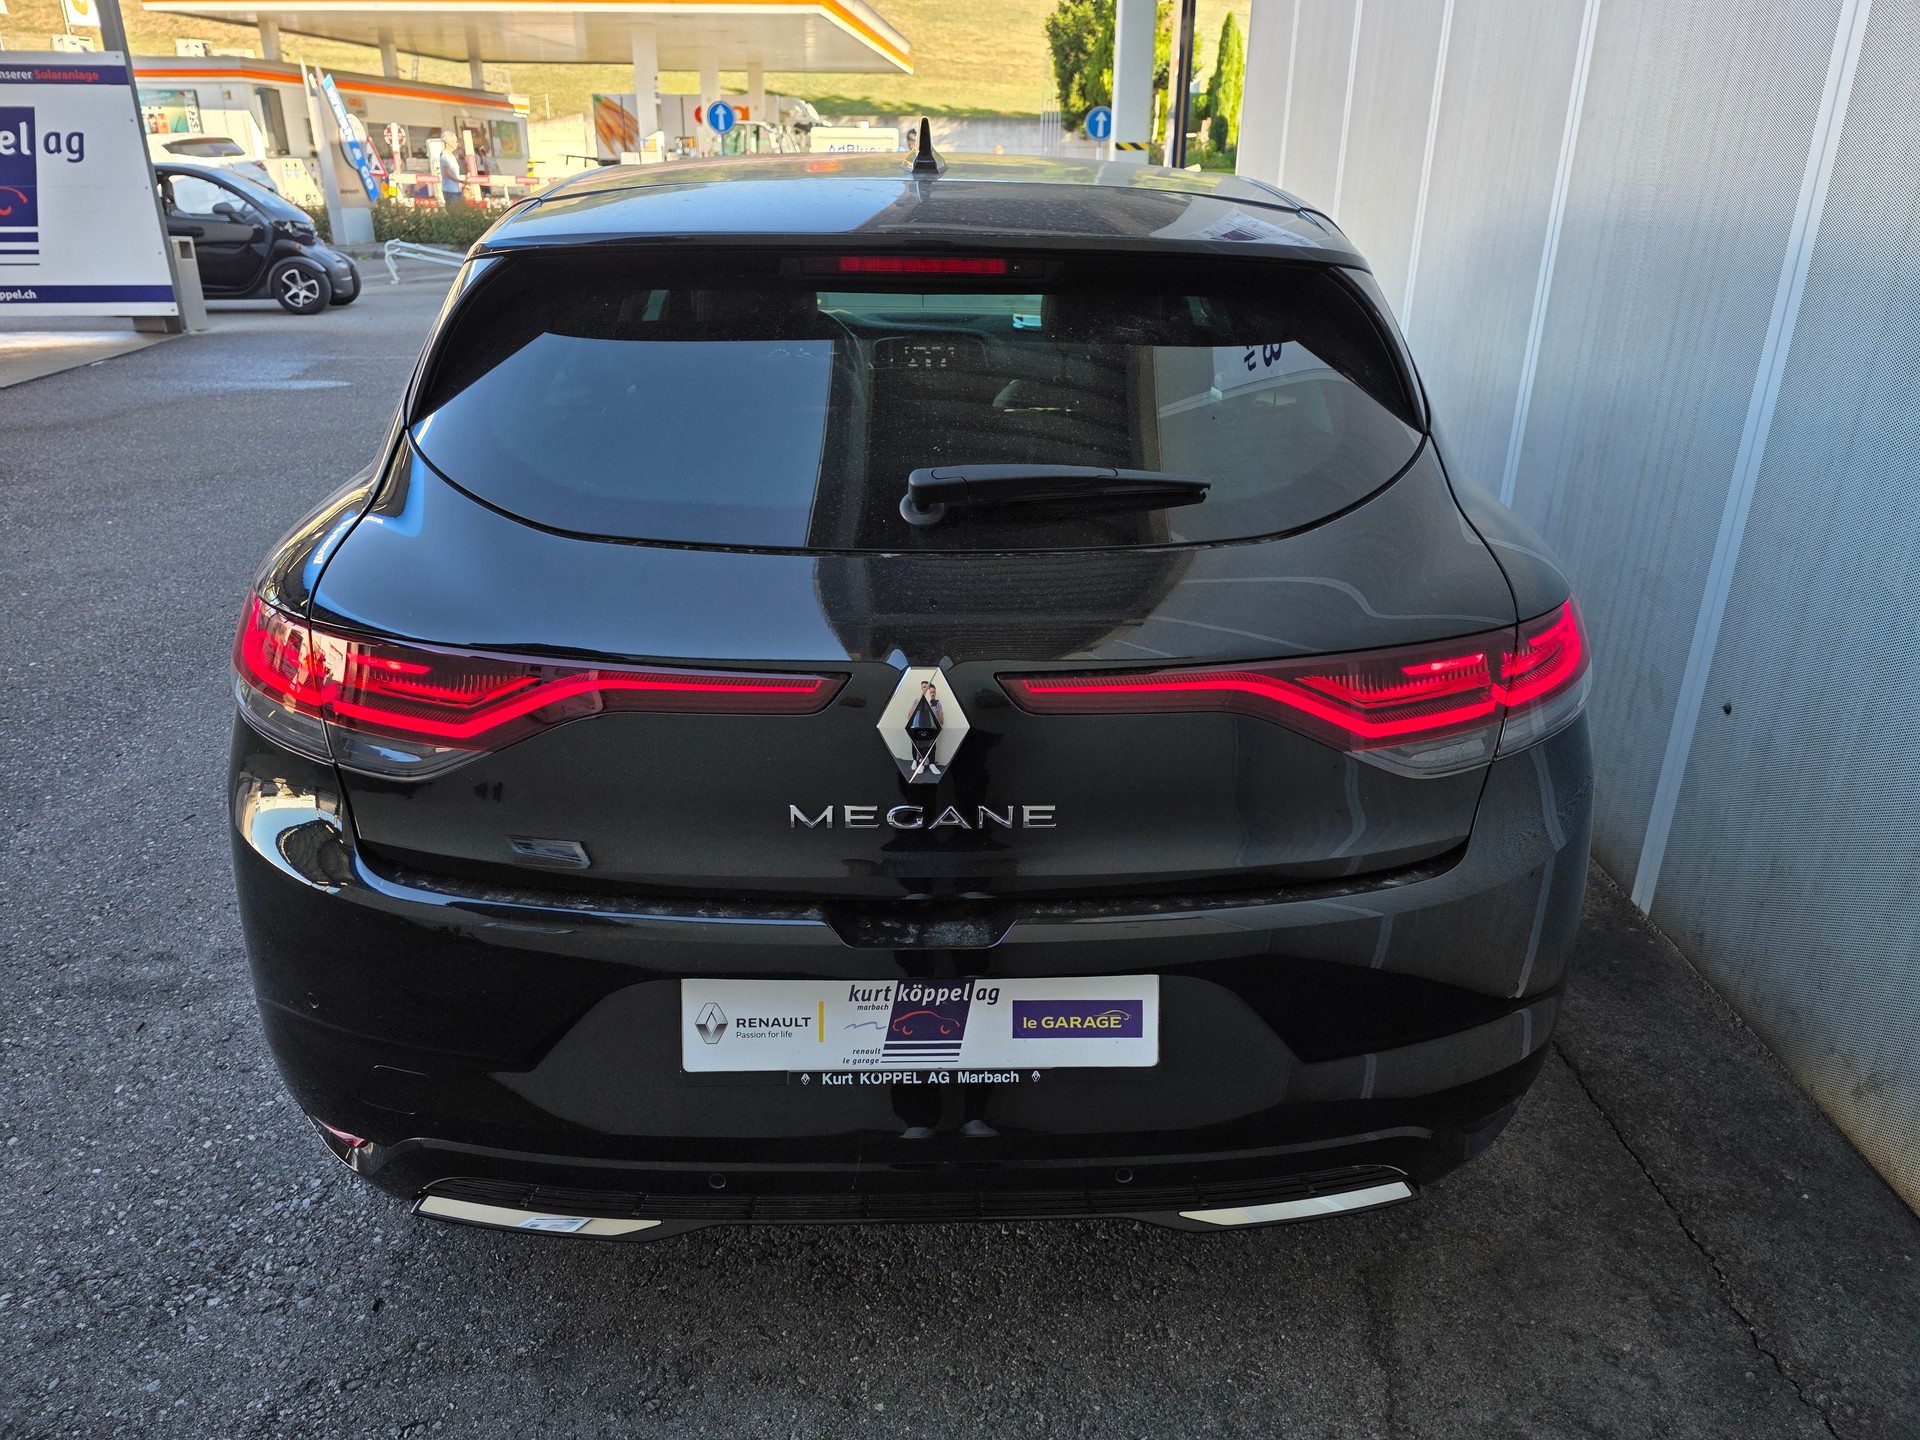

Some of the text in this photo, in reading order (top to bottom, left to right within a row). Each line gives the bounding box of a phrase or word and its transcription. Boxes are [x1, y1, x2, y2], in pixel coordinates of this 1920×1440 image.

[34, 69, 98, 83] Solaranlage
[44, 131, 84, 163] ag
[789, 804, 1057, 829] MEGANE
[848, 983, 1000, 1006] kurt köppel ag
[857, 1003, 889, 1011] marbach
[736, 1017, 811, 1028] RENAULT
[1022, 1016, 1122, 1028] le GARAGE
[736, 1030, 793, 1039] Passion for life
[822, 1073, 853, 1085] Kurt
[927, 1072, 950, 1084] AG
[957, 1071, 1019, 1083] Marbach
